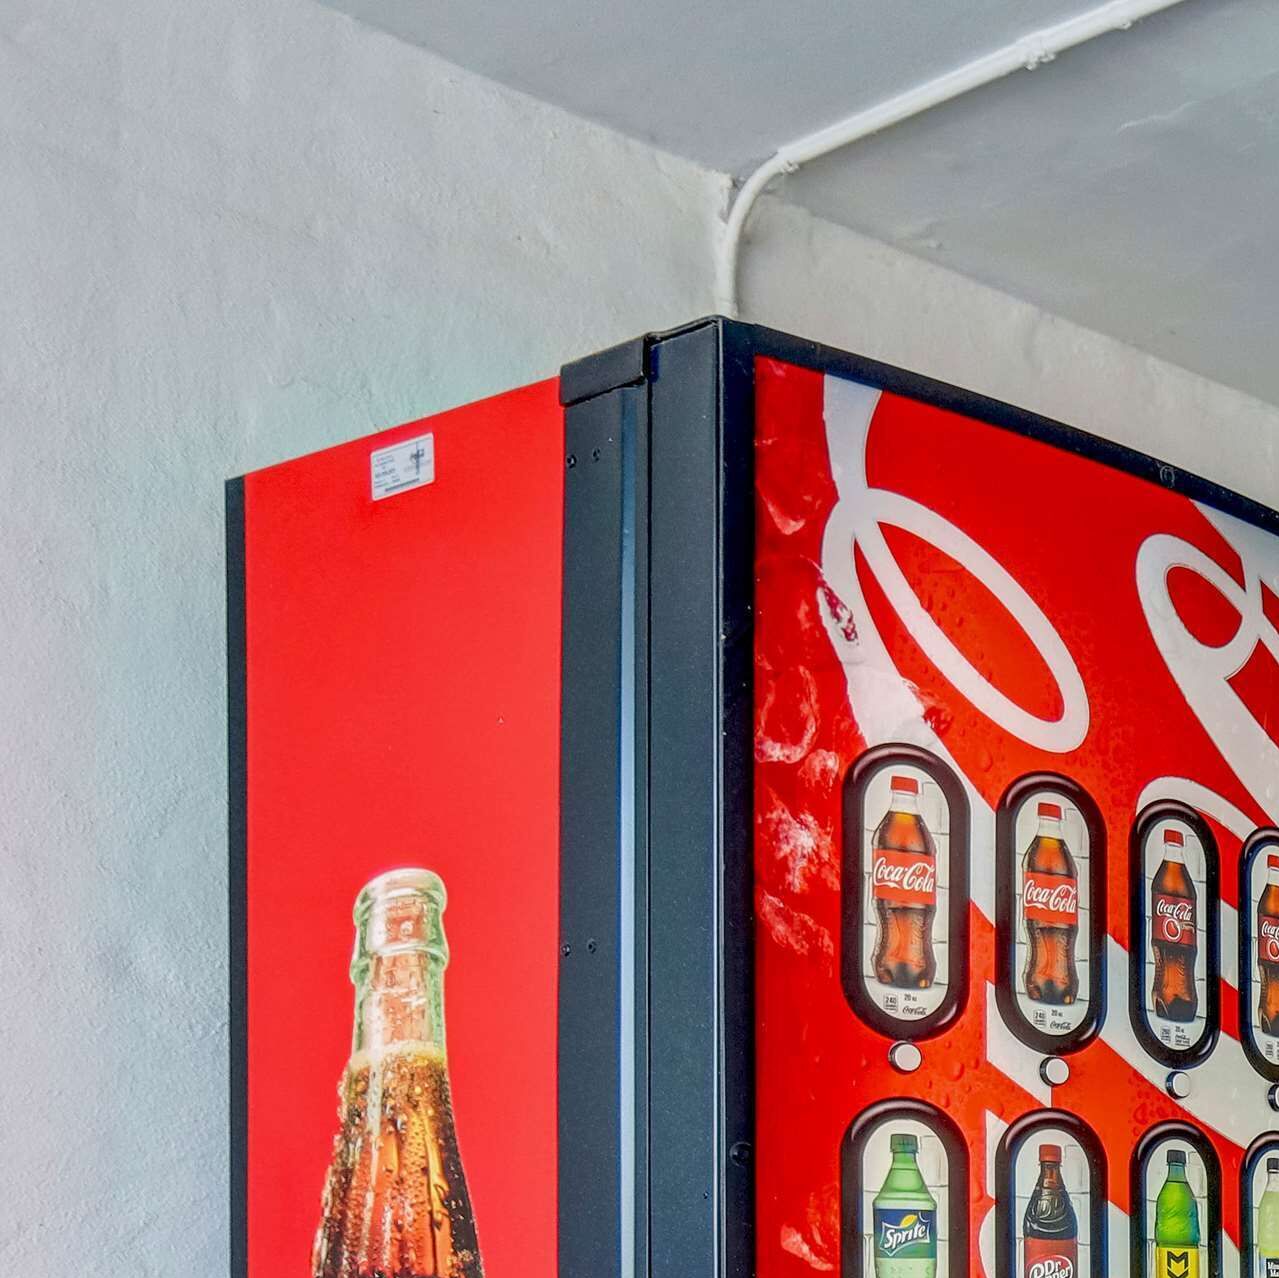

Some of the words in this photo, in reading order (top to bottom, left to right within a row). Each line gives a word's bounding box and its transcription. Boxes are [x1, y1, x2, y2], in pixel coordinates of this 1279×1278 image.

[874, 857, 935, 893] Coca-Cola
[1024, 880, 1077, 913] Coca-Cola
[1157, 899, 1192, 921] Coca-Cola
[884, 1224, 927, 1249] Sprite
[1045, 1259, 1061, 1276] Dr
